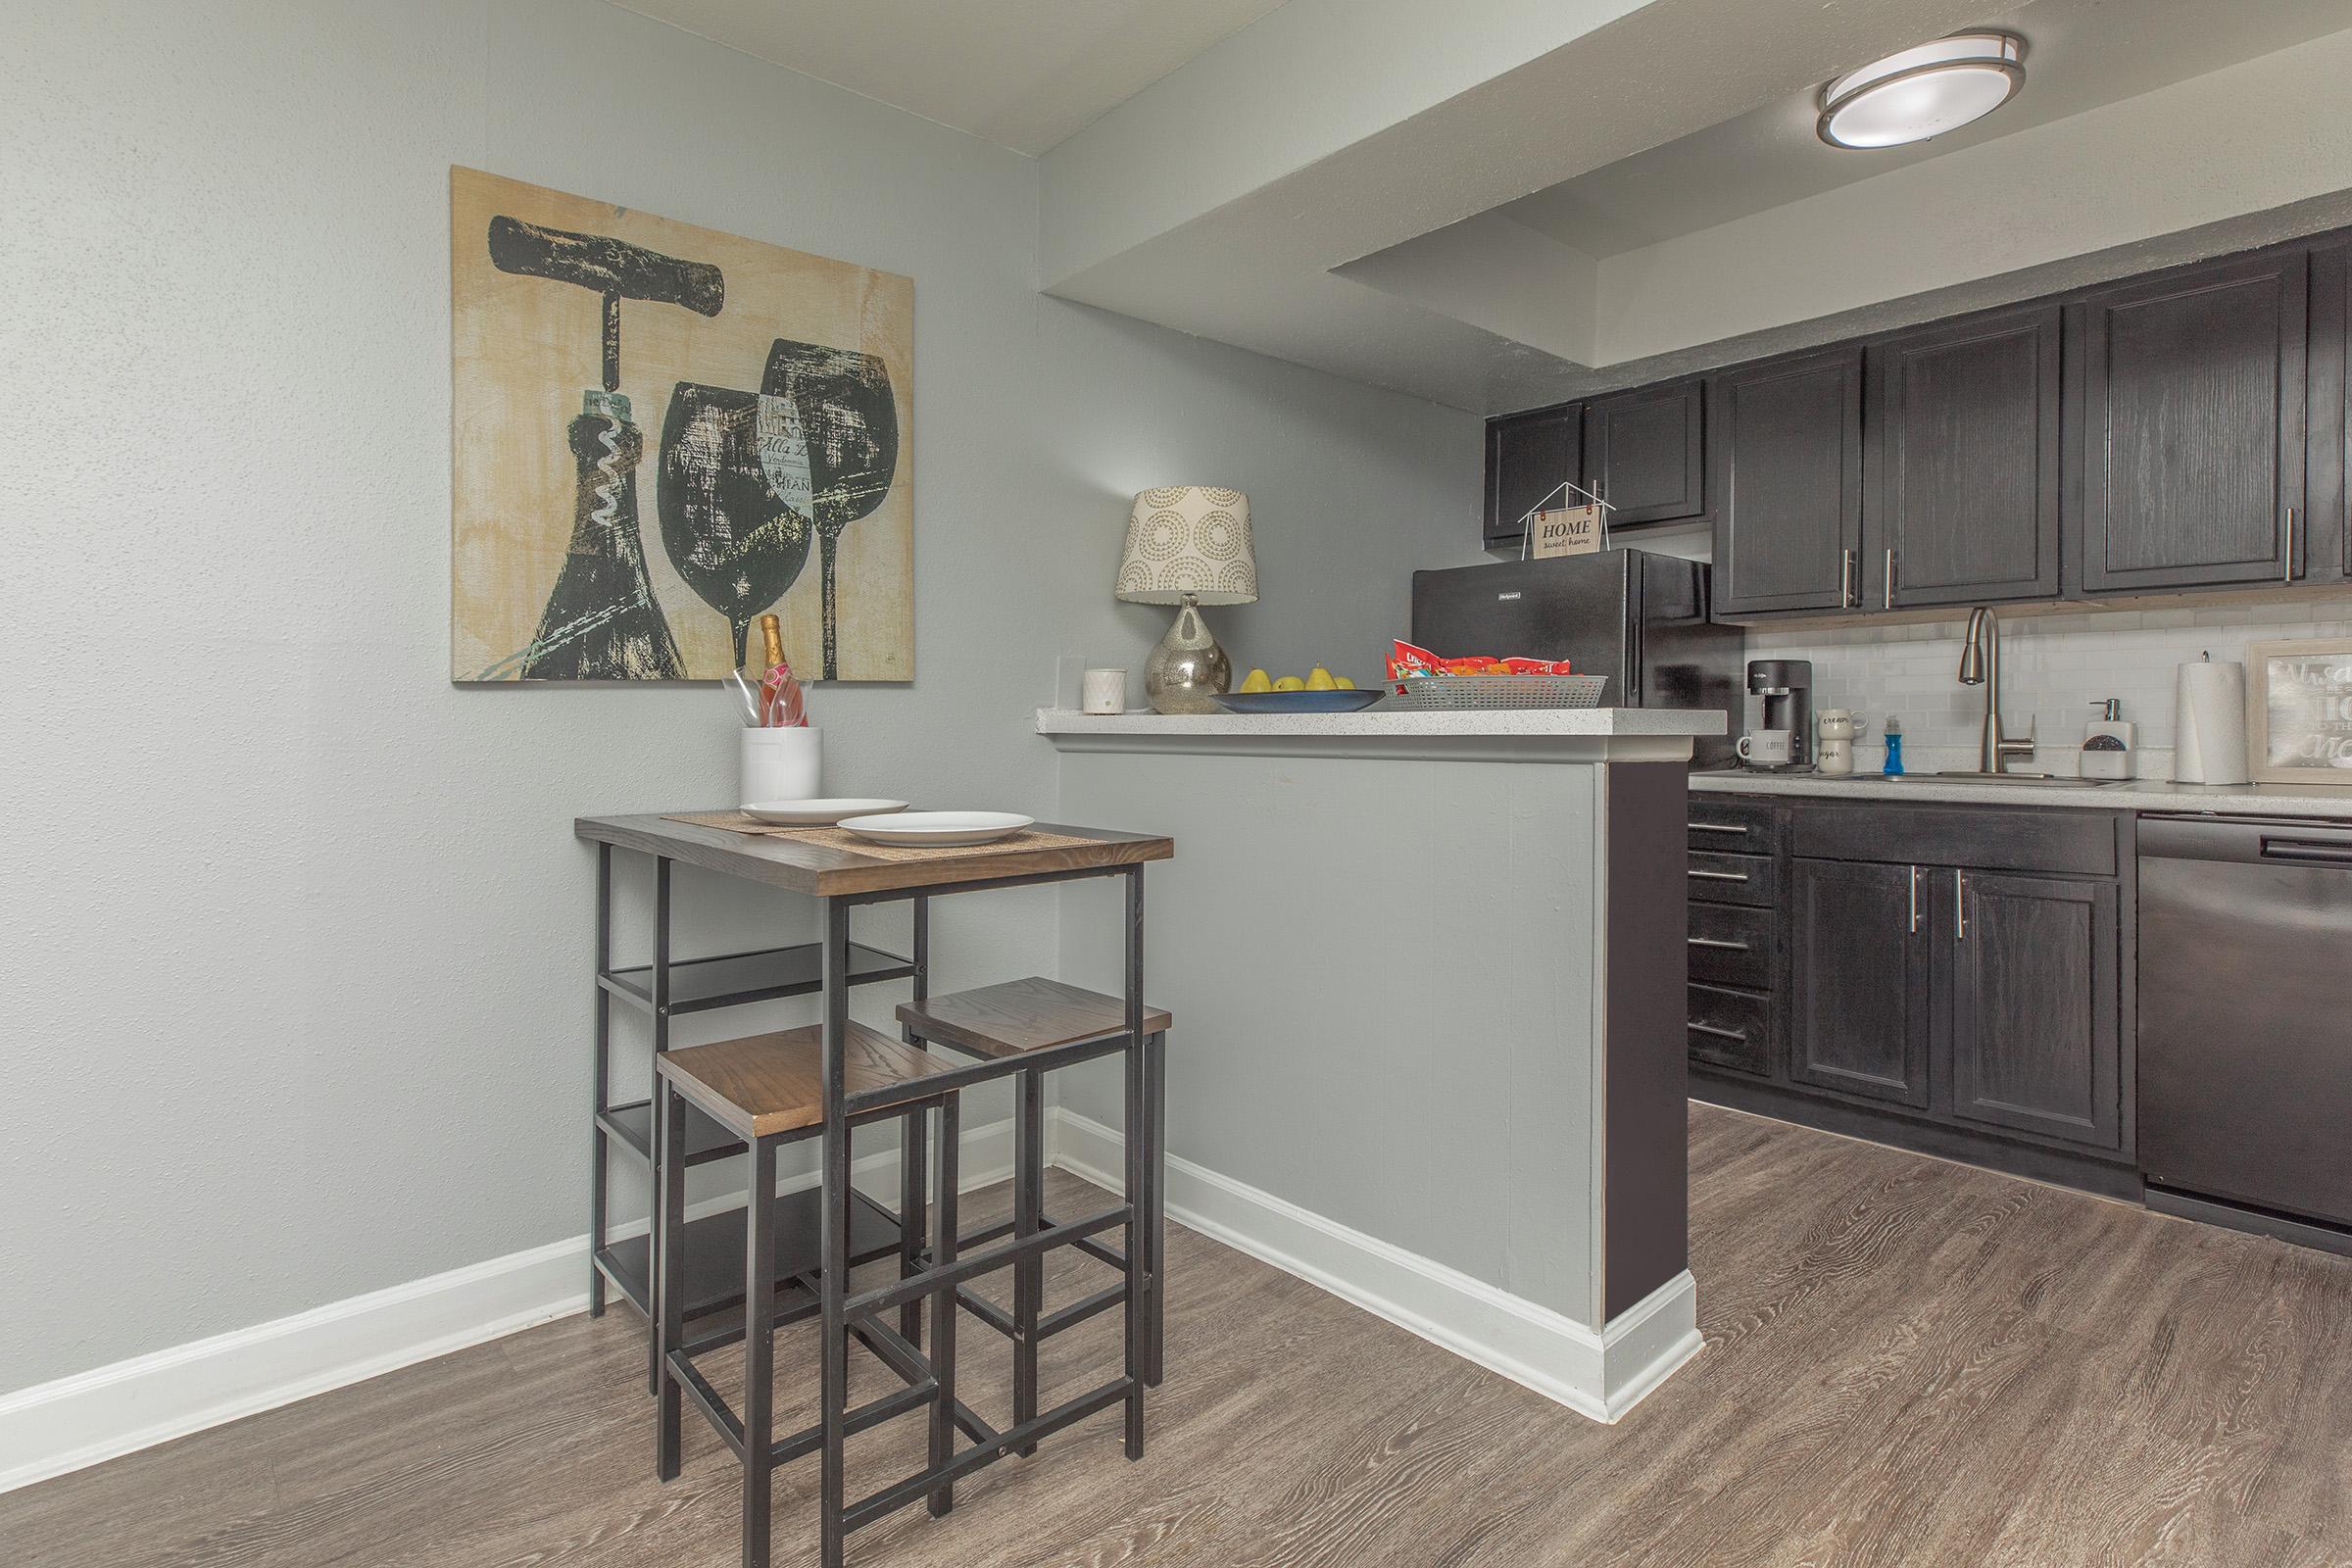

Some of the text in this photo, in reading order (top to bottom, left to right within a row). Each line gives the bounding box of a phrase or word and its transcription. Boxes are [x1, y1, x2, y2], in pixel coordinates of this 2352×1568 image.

[1543, 519, 1592, 539] HOME
[1544, 537, 1591, 549] sweet home
[1765, 740, 1786, 751] COFFEE
